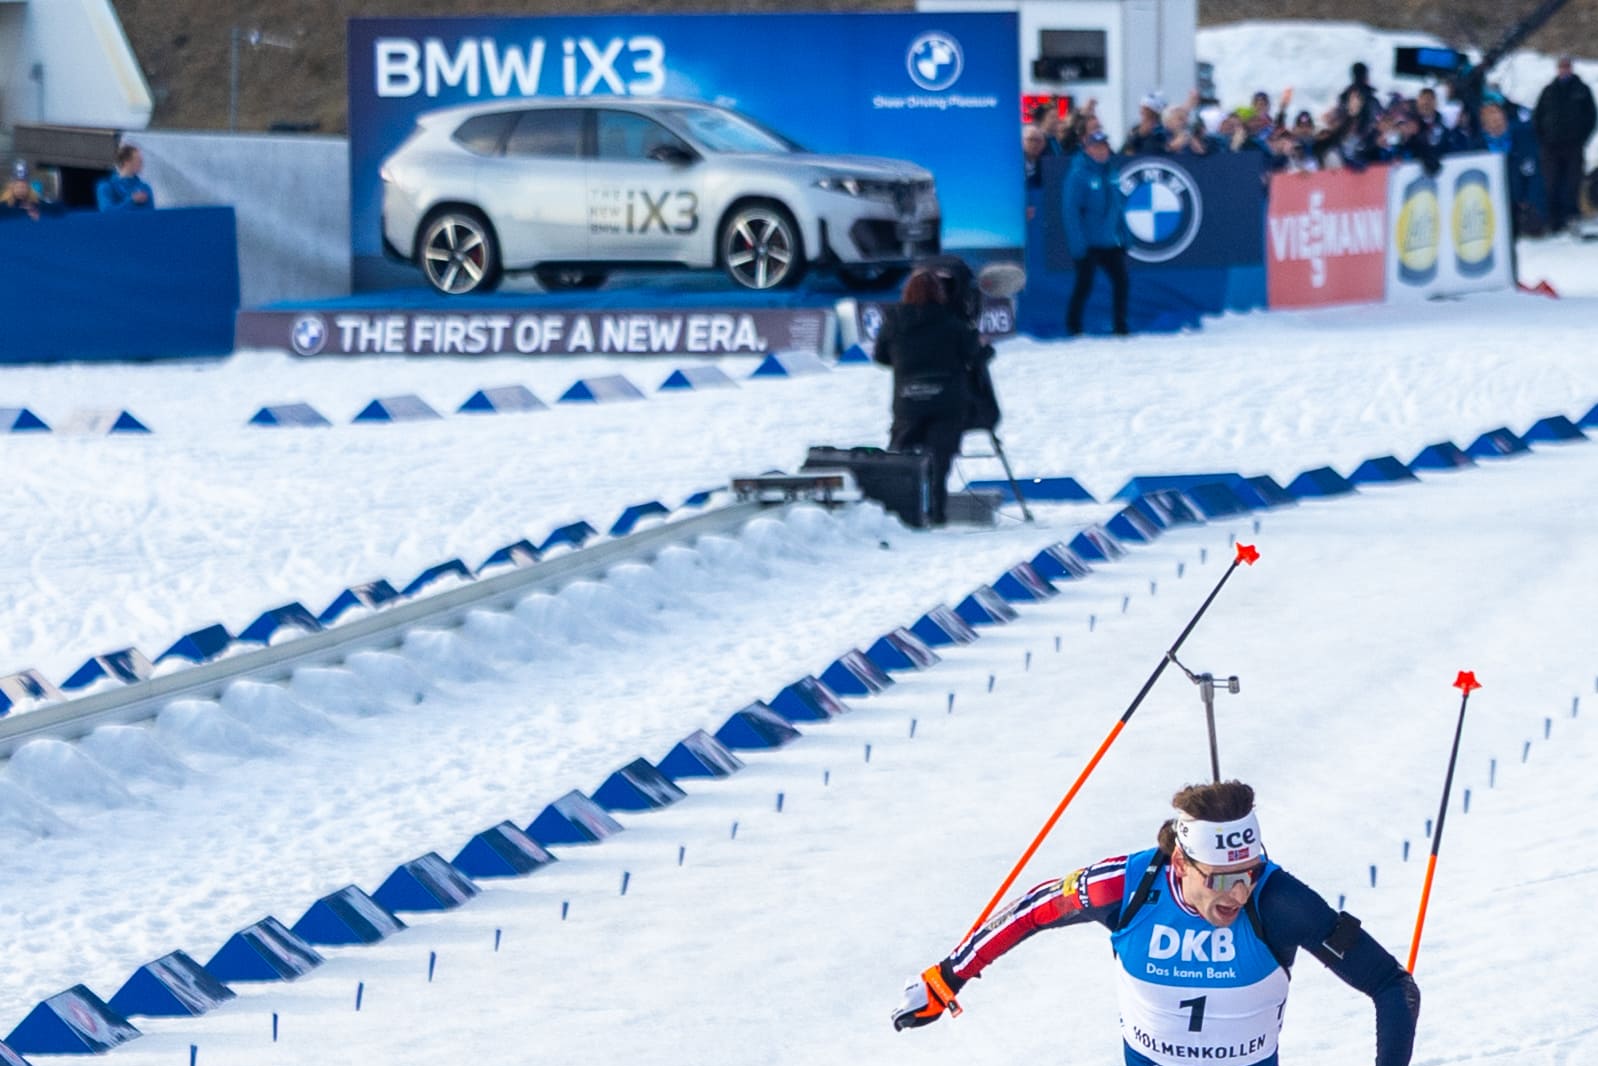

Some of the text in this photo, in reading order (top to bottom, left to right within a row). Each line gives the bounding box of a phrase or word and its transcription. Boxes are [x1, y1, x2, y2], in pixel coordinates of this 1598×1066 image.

[375, 35, 666, 98] BMW iX3
[872, 95, 998, 111] Sheer Driving Pleasure
[625, 188, 699, 235] iX3
[335, 314, 408, 353] THE
[412, 314, 512, 354] FIRST
[514, 314, 565, 354] OF
[567, 314, 596, 353] A
[601, 314, 684, 353] NEW
[686, 313, 768, 353] ERA.
[1215, 826, 1256, 850] ice
[1147, 923, 1237, 963] DKB
[1146, 962, 1237, 980] Das kann Bank
[1178, 994, 1207, 1033] 1
[1132, 1025, 1267, 1060] HOLMENKOLLEN
